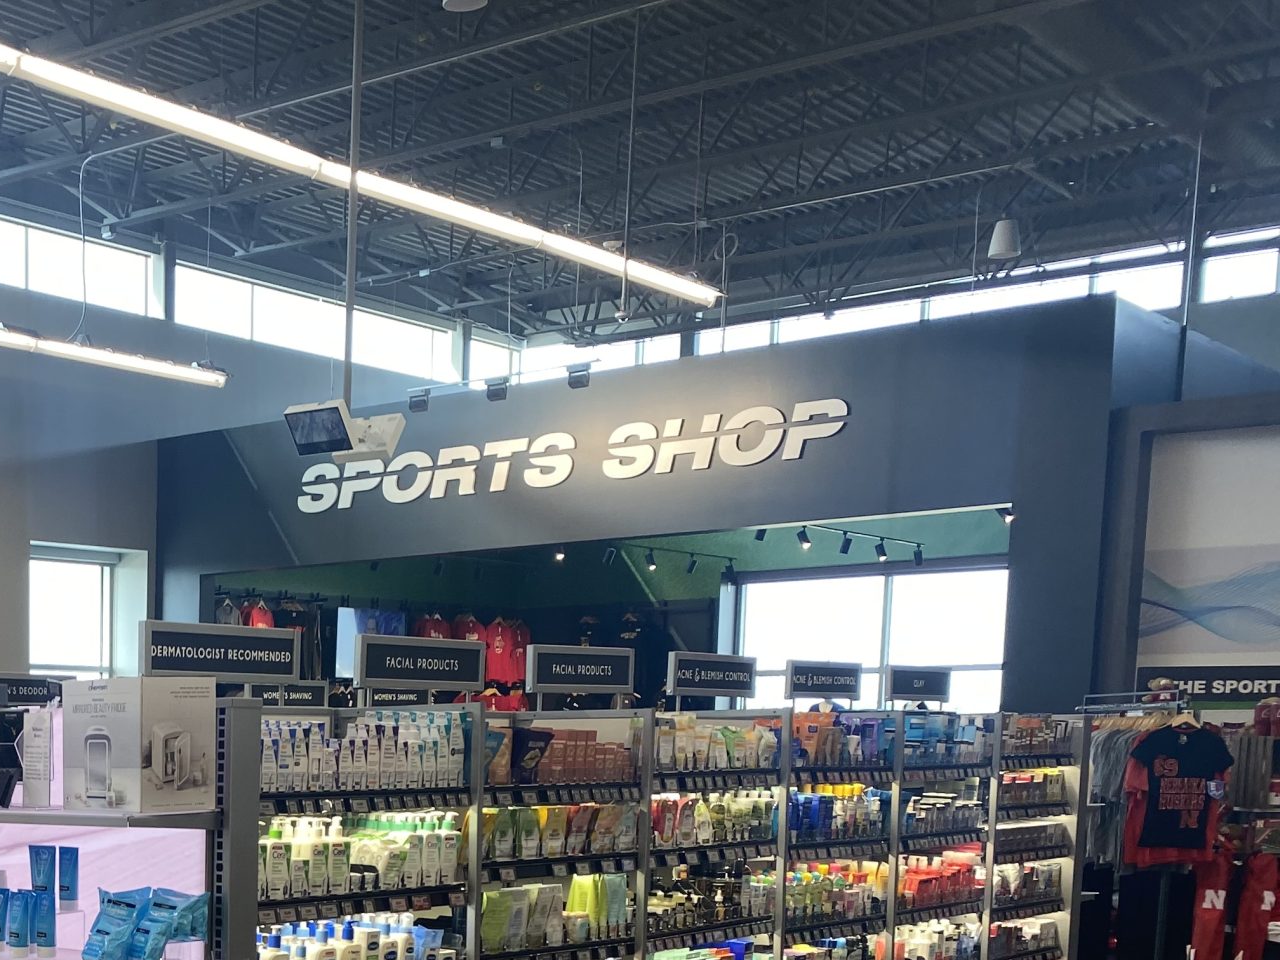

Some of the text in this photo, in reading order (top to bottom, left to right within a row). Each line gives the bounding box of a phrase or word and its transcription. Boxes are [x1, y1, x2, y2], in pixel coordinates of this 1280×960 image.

[297, 398, 849, 514] SPORTS SHOP
[151, 645, 291, 662] DERMATOLOGIST RECOMMENDED
[386, 656, 459, 671] FACIAL PRODUCTS
[552, 664, 612, 676] FACIAL PRODUCTS
[677, 668, 751, 682] ACNE & BLEMISH CONTROL
[793, 675, 807, 684] ACNE
[813, 675, 833, 685] BLEMISH
[833, 676, 856, 685] CONTROL
[1211, 679, 1280, 694] SPORT
[263, 691, 313, 700] WOME'S SHAVING
[373, 693, 418, 701] WOMEN'S SHAVING
[1202, 889, 1227, 910] N
